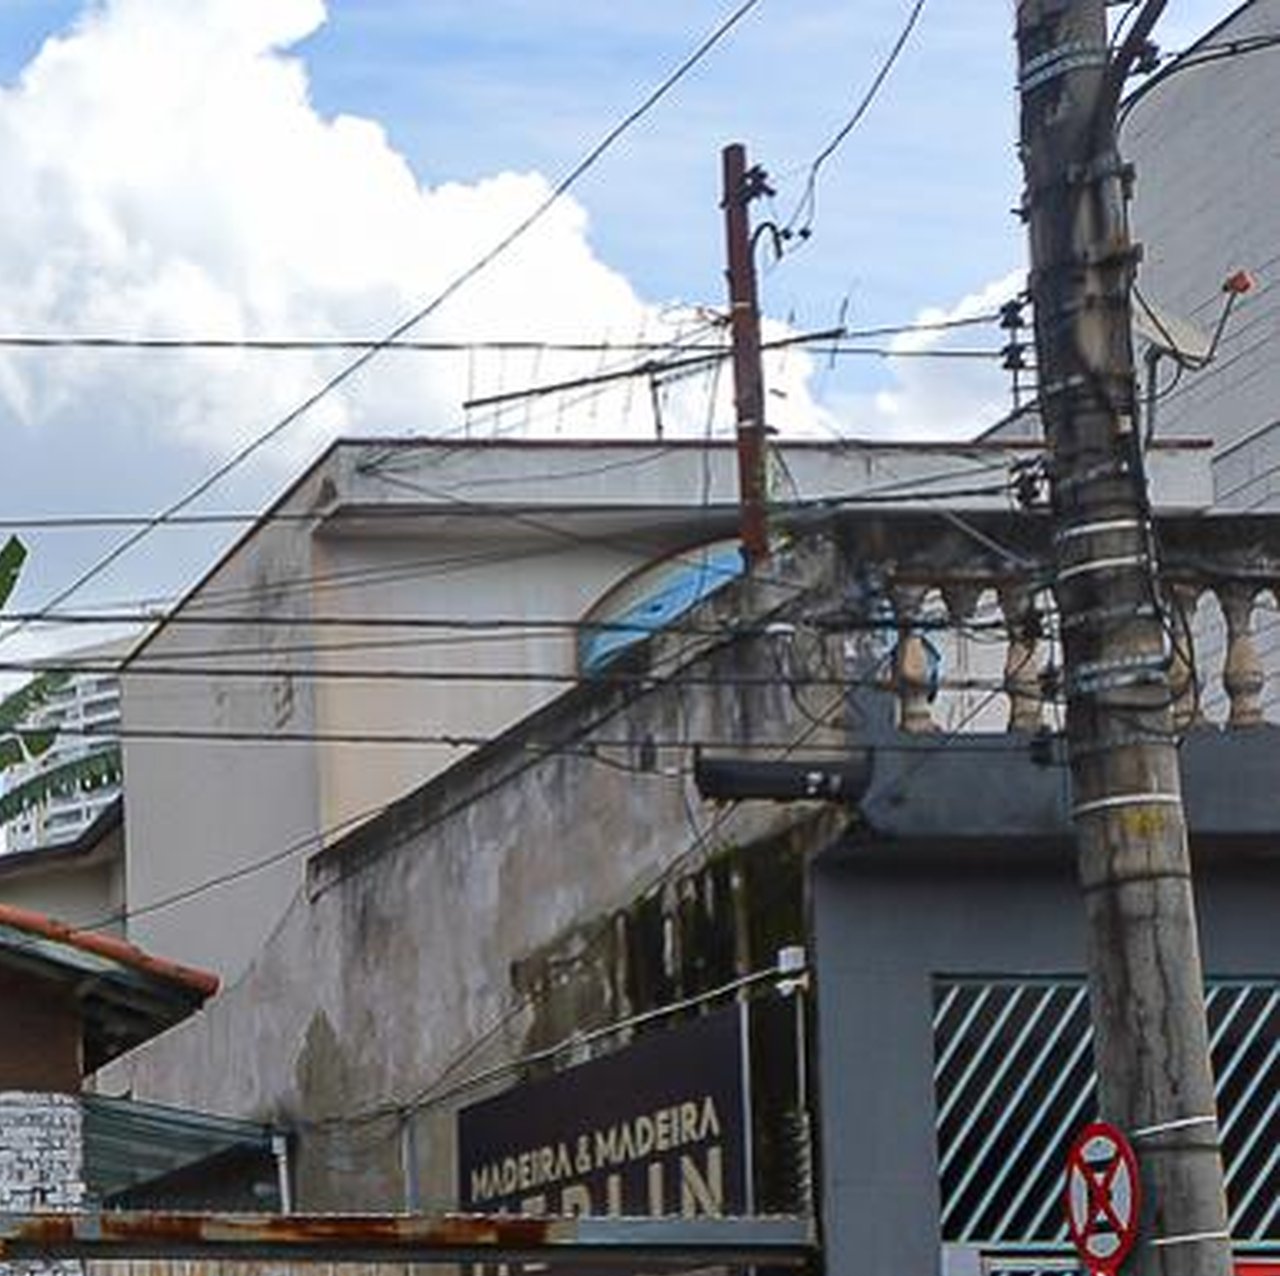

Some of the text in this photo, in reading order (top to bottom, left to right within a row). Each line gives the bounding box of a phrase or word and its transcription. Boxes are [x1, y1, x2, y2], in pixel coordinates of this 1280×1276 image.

[470, 1095, 720, 1202] MADEIRA & MADEIRA
